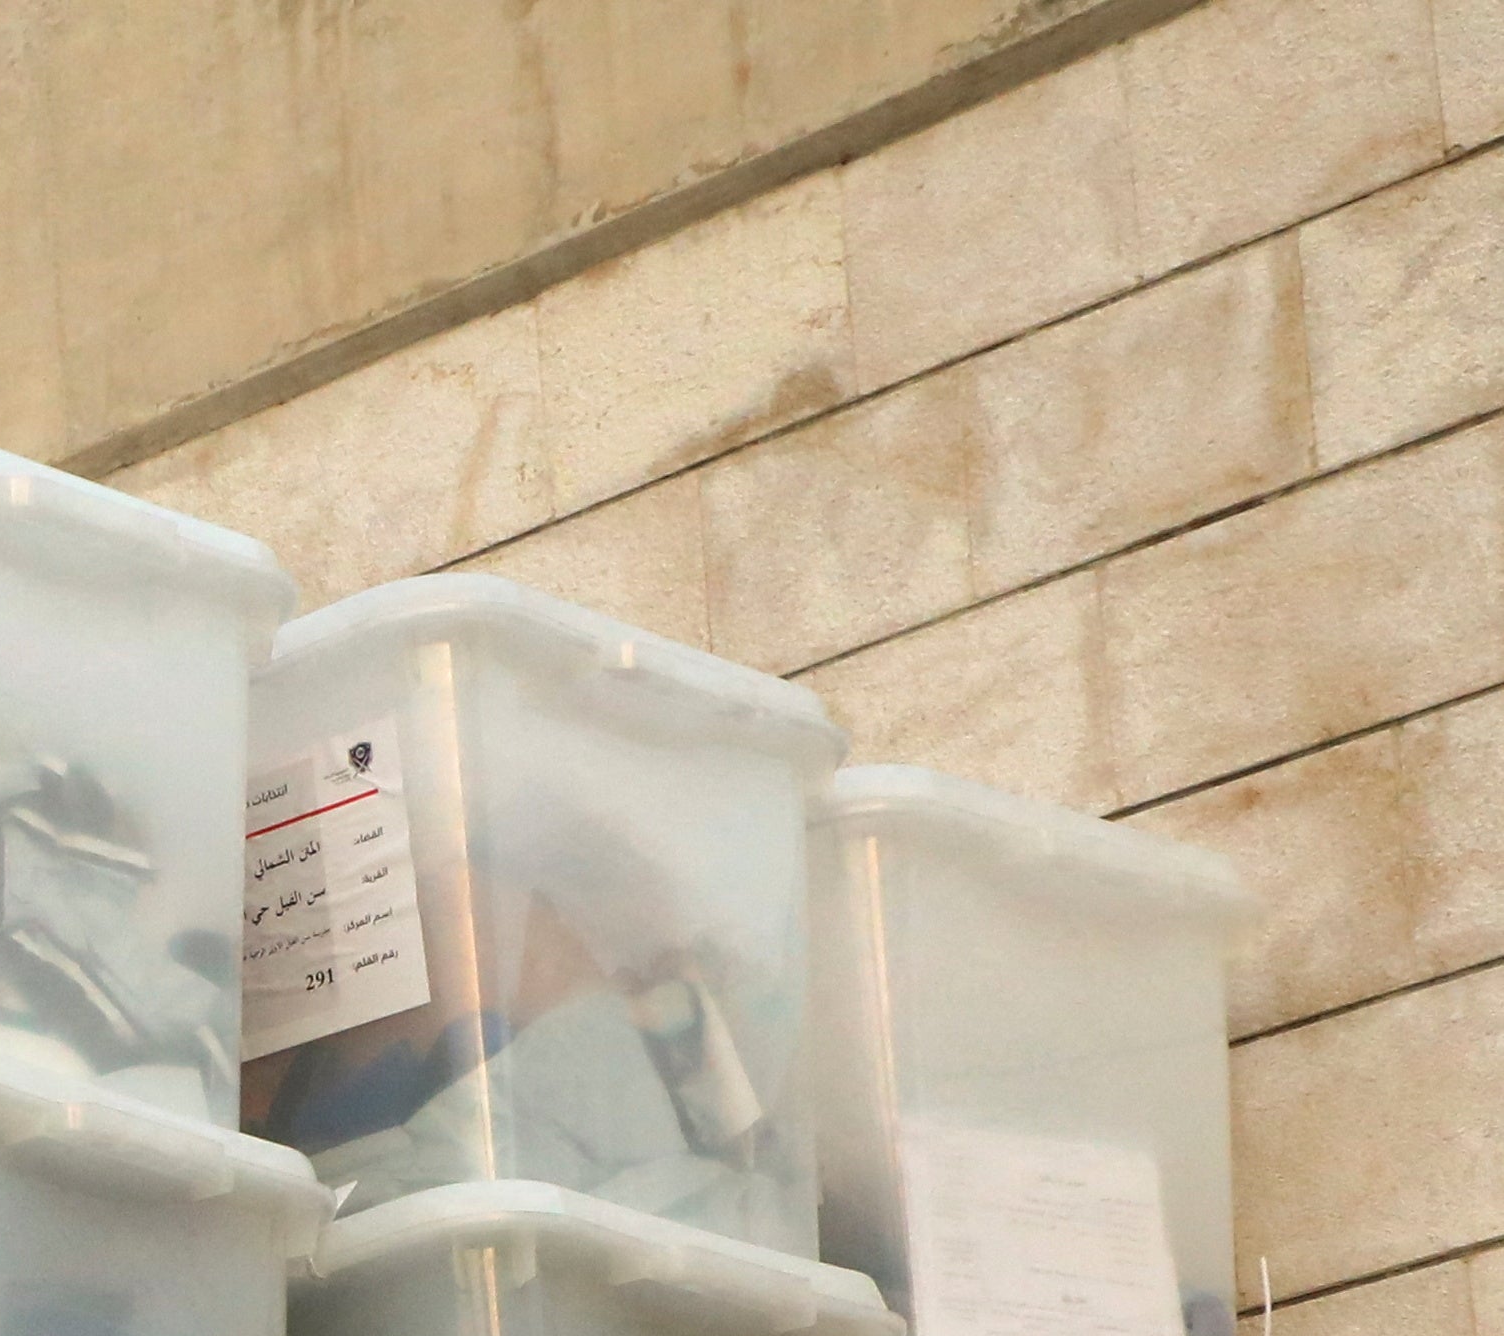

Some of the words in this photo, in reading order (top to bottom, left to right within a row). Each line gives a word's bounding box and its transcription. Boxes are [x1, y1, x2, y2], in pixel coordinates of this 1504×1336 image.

[354, 826, 384, 846] القضاء:
[299, 840, 321, 863] المتن
[254, 849, 295, 882] الشمالي
[352, 953, 379, 973] القلم:
[381, 949, 399, 965] رقم
[305, 968, 335, 992] 291
